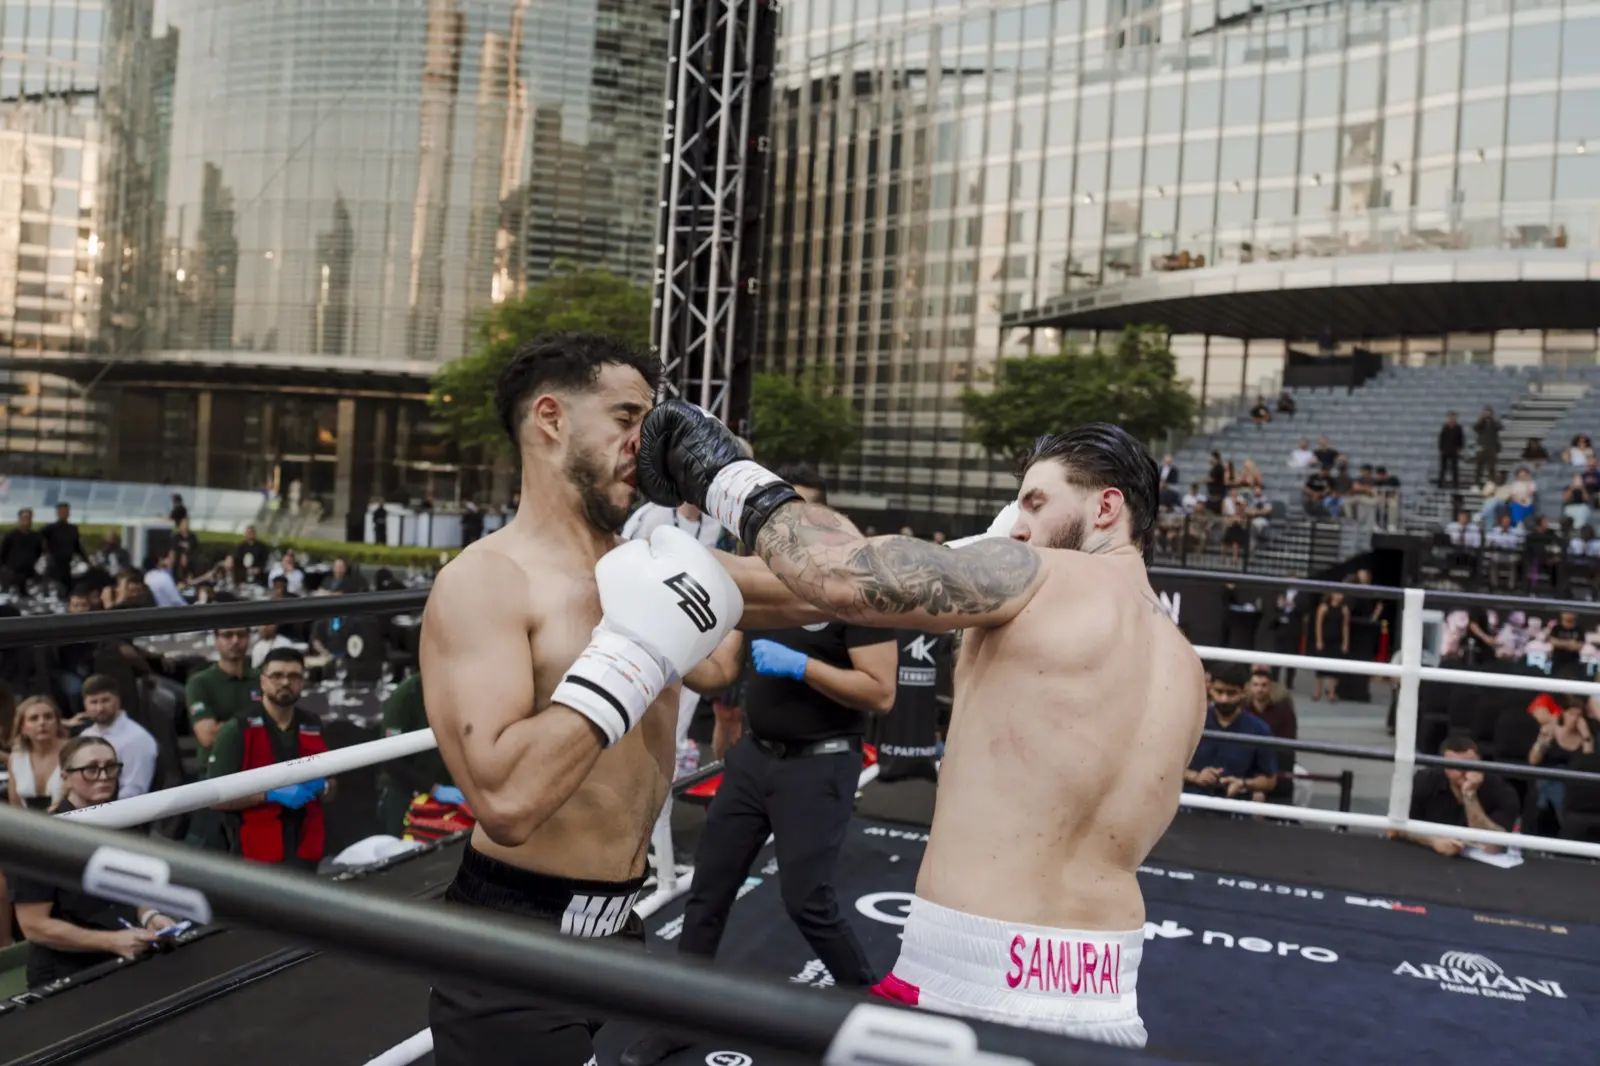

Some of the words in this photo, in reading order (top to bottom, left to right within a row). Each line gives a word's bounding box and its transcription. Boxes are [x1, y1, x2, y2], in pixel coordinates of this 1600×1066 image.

[1006, 933, 1120, 994] SAMURAI
[1202, 929, 1339, 963] nero
[1393, 960, 1568, 998] ARMANI
